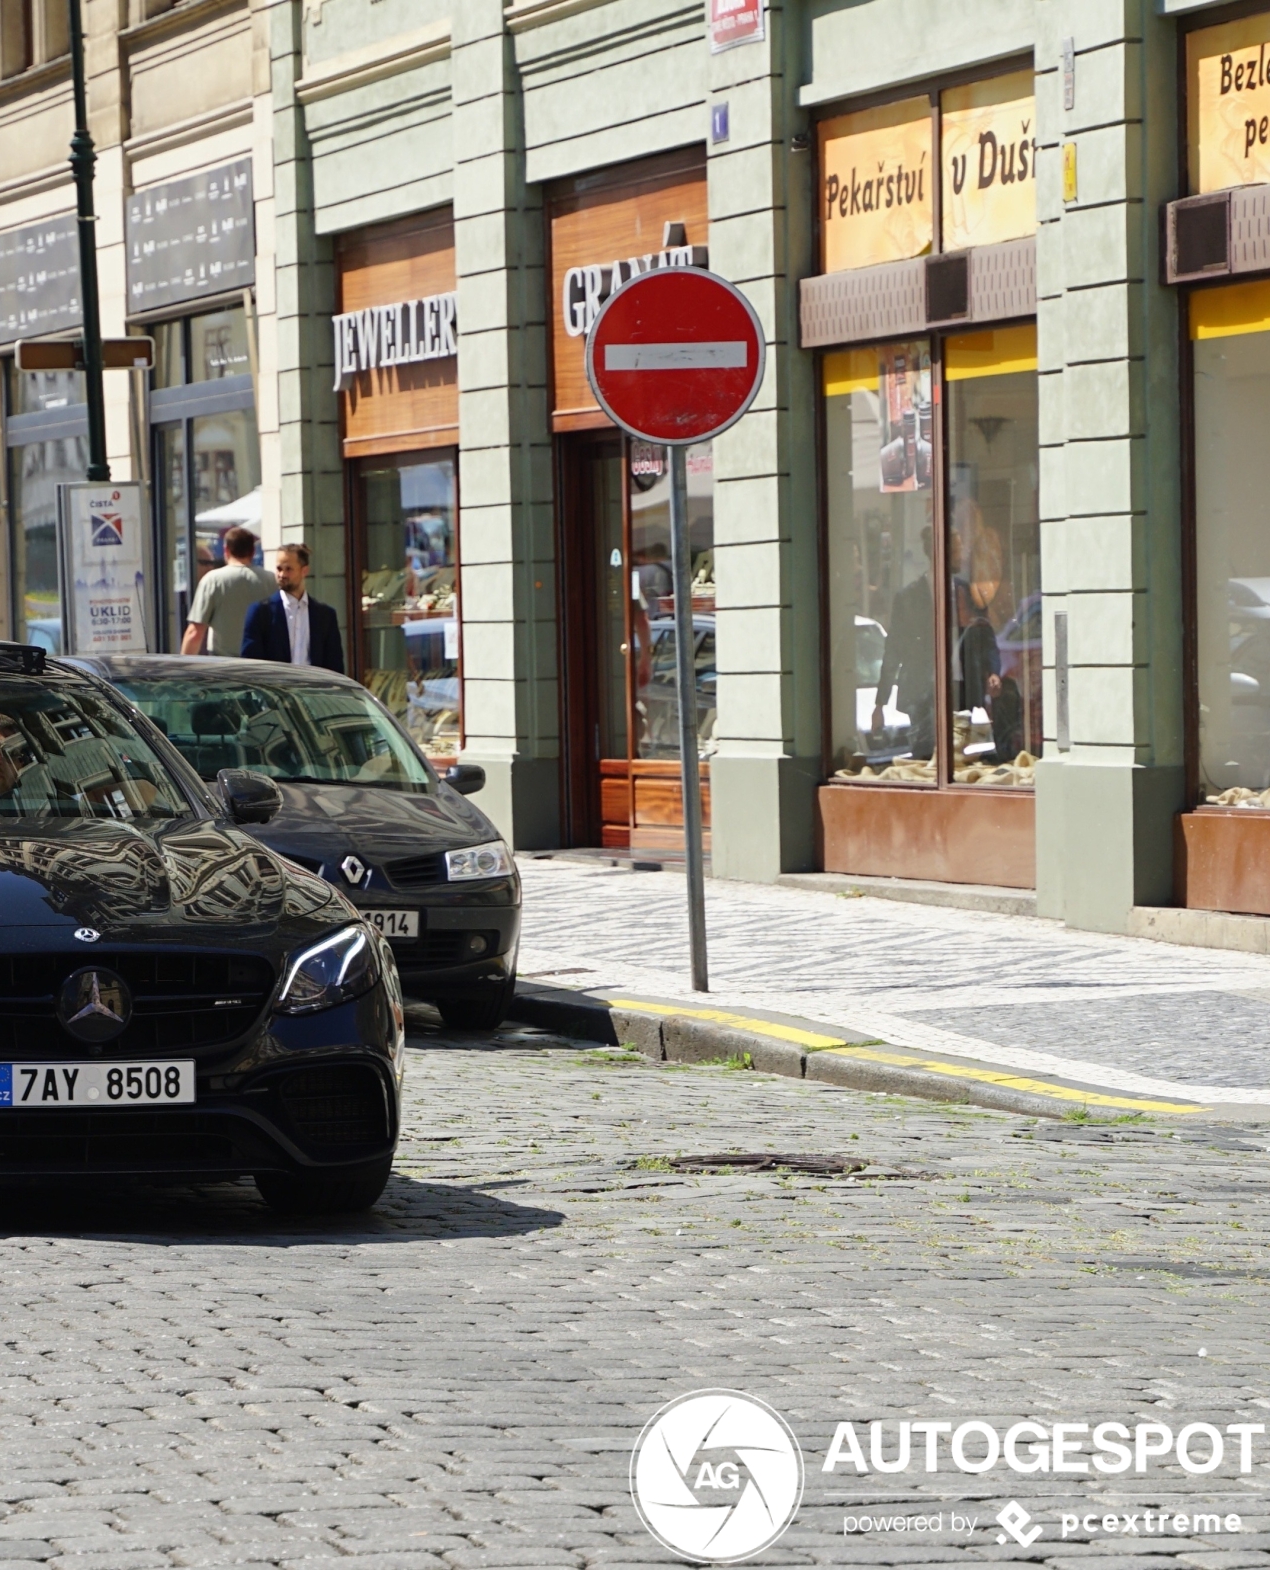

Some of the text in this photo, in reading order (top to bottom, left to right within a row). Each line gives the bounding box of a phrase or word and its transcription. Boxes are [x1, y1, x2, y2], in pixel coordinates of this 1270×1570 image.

[825, 150, 926, 220] Pekařství
[951, 153, 967, 195] v
[331, 291, 458, 392] JEWELLER
[20, 1066, 180, 1101] 7AY 8508
